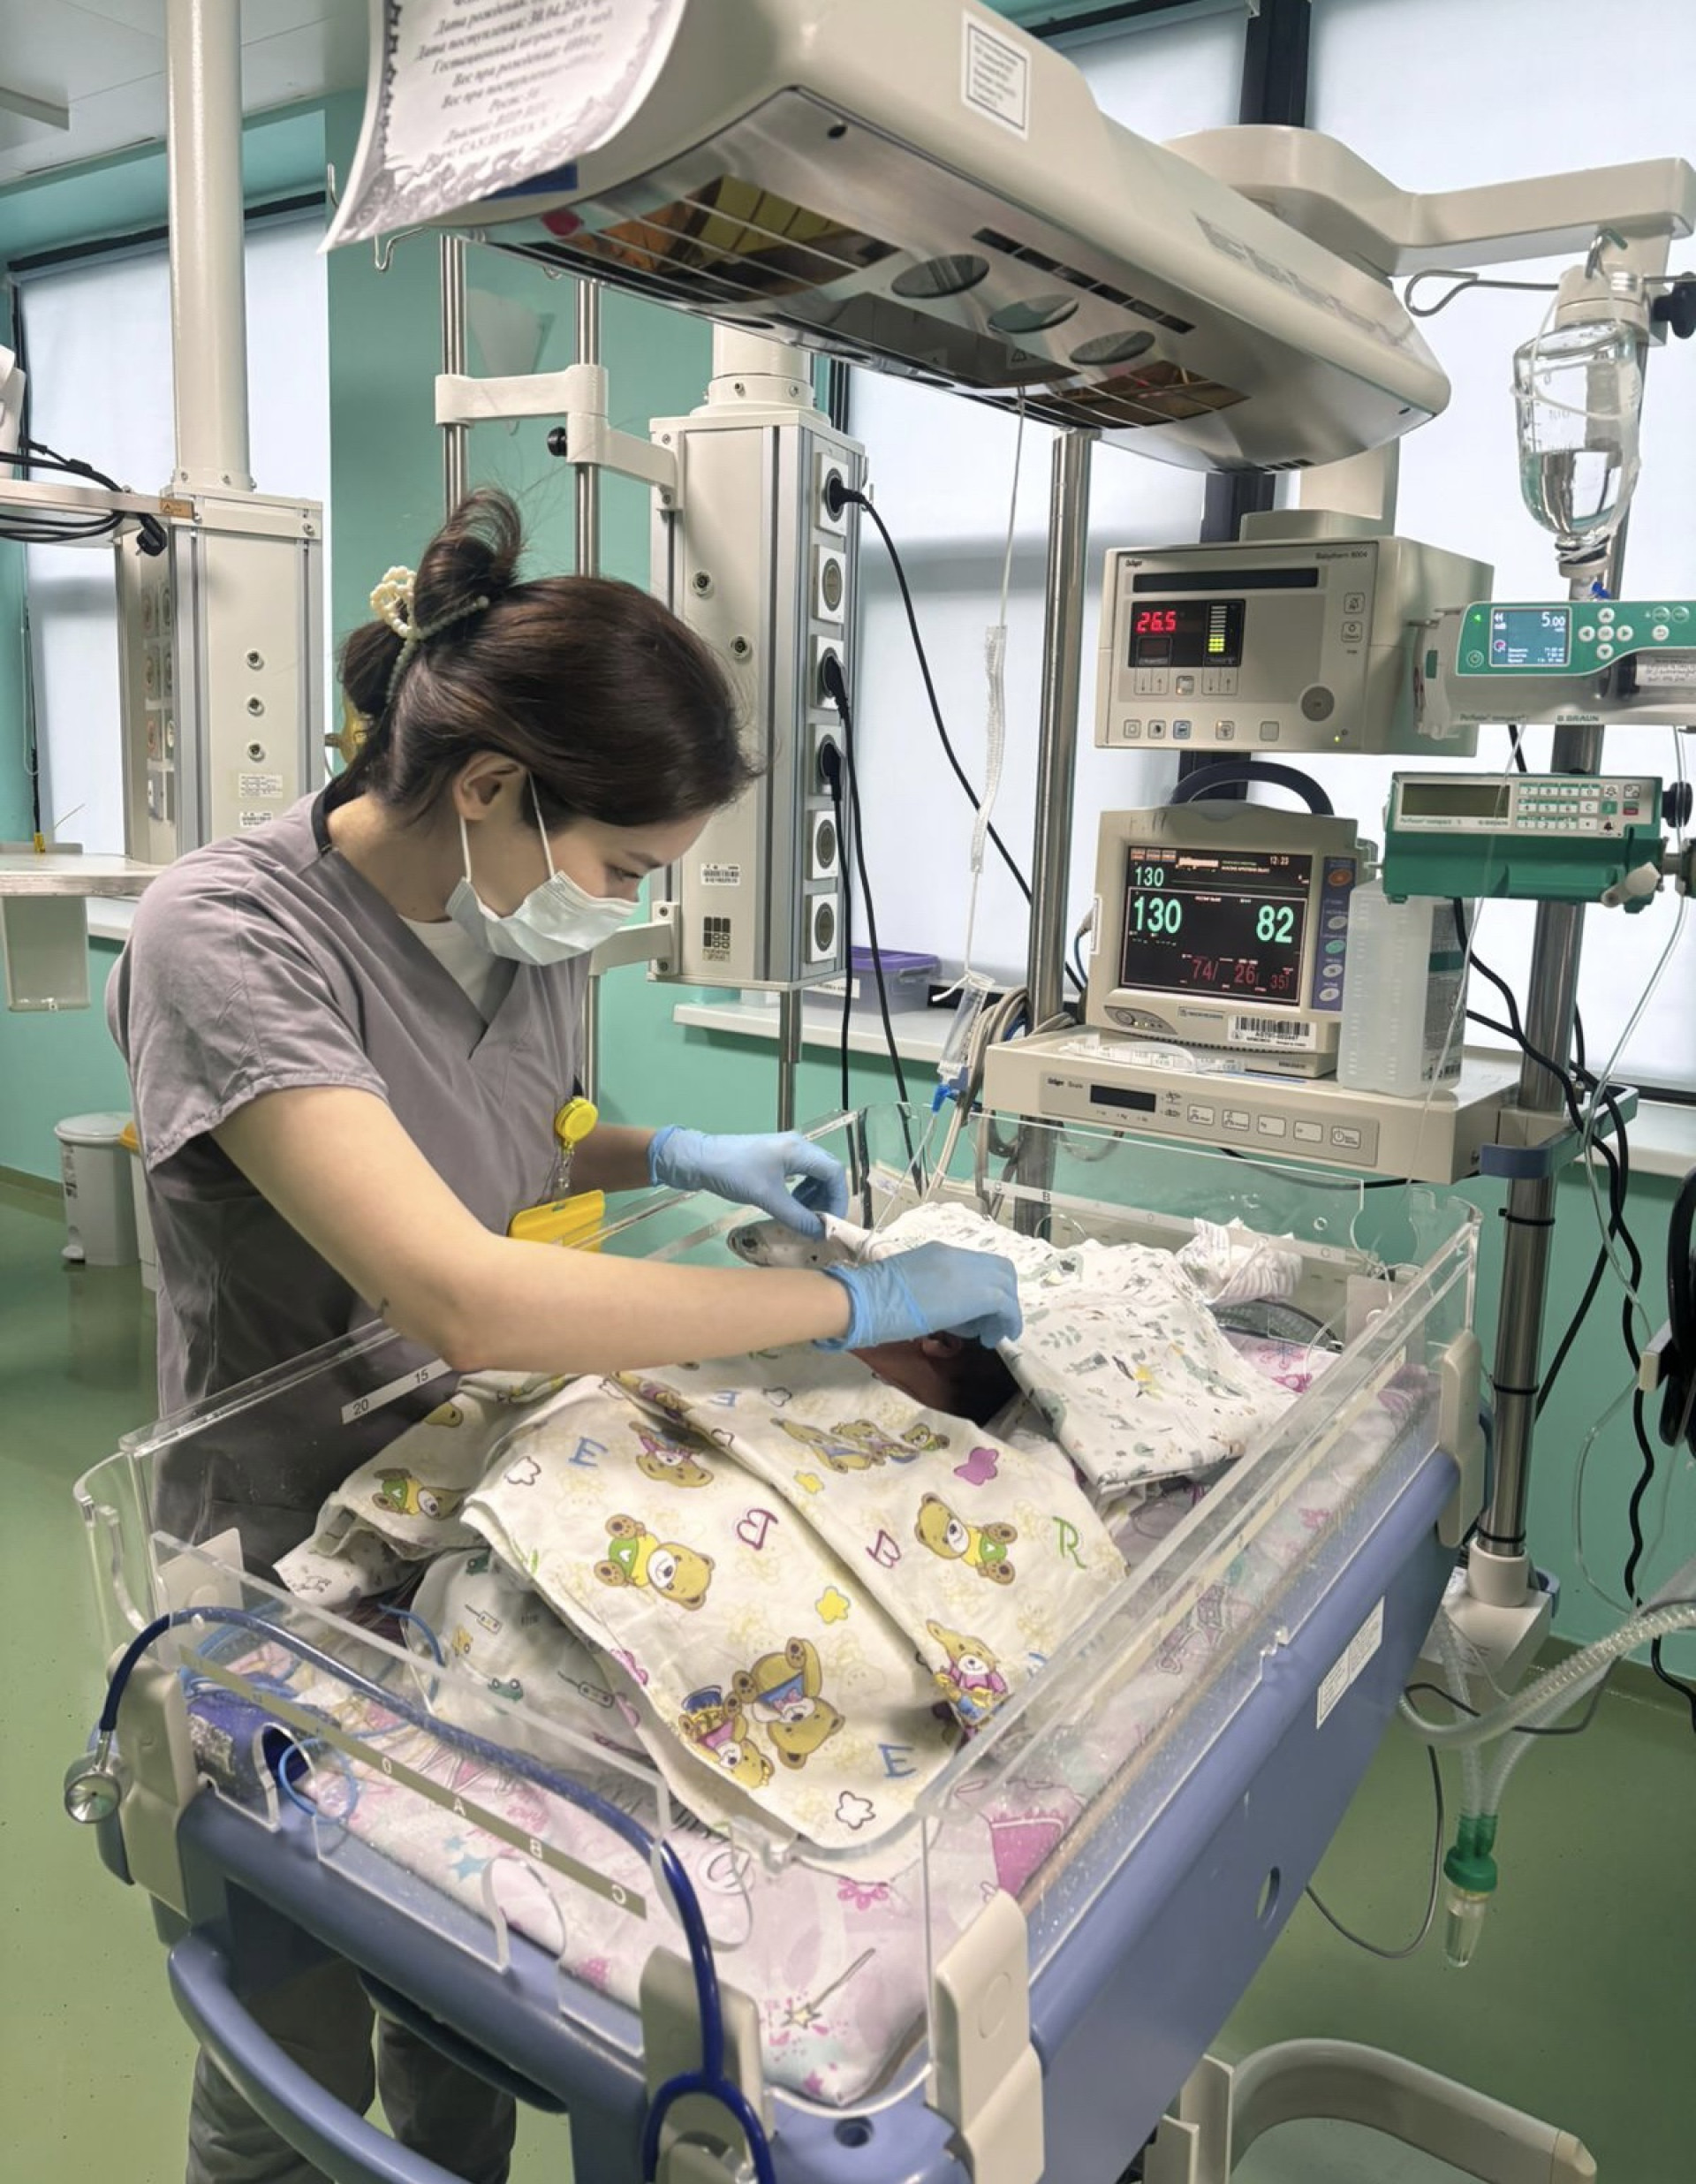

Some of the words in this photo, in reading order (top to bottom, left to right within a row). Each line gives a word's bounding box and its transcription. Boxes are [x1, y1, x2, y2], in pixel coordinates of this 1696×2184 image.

[1542, 611, 1565, 626] 5.00
[1134, 866, 1164, 887] 130
[1133, 896, 1182, 934] 130
[1256, 905, 1294, 944] 82
[415, 1369, 429, 1384] 15
[353, 1399, 369, 1415] 20
[568, 1436, 609, 1467] E
[735, 1508, 779, 1551] B
[1053, 1516, 1086, 1570] R
[877, 1742, 917, 1779] E
